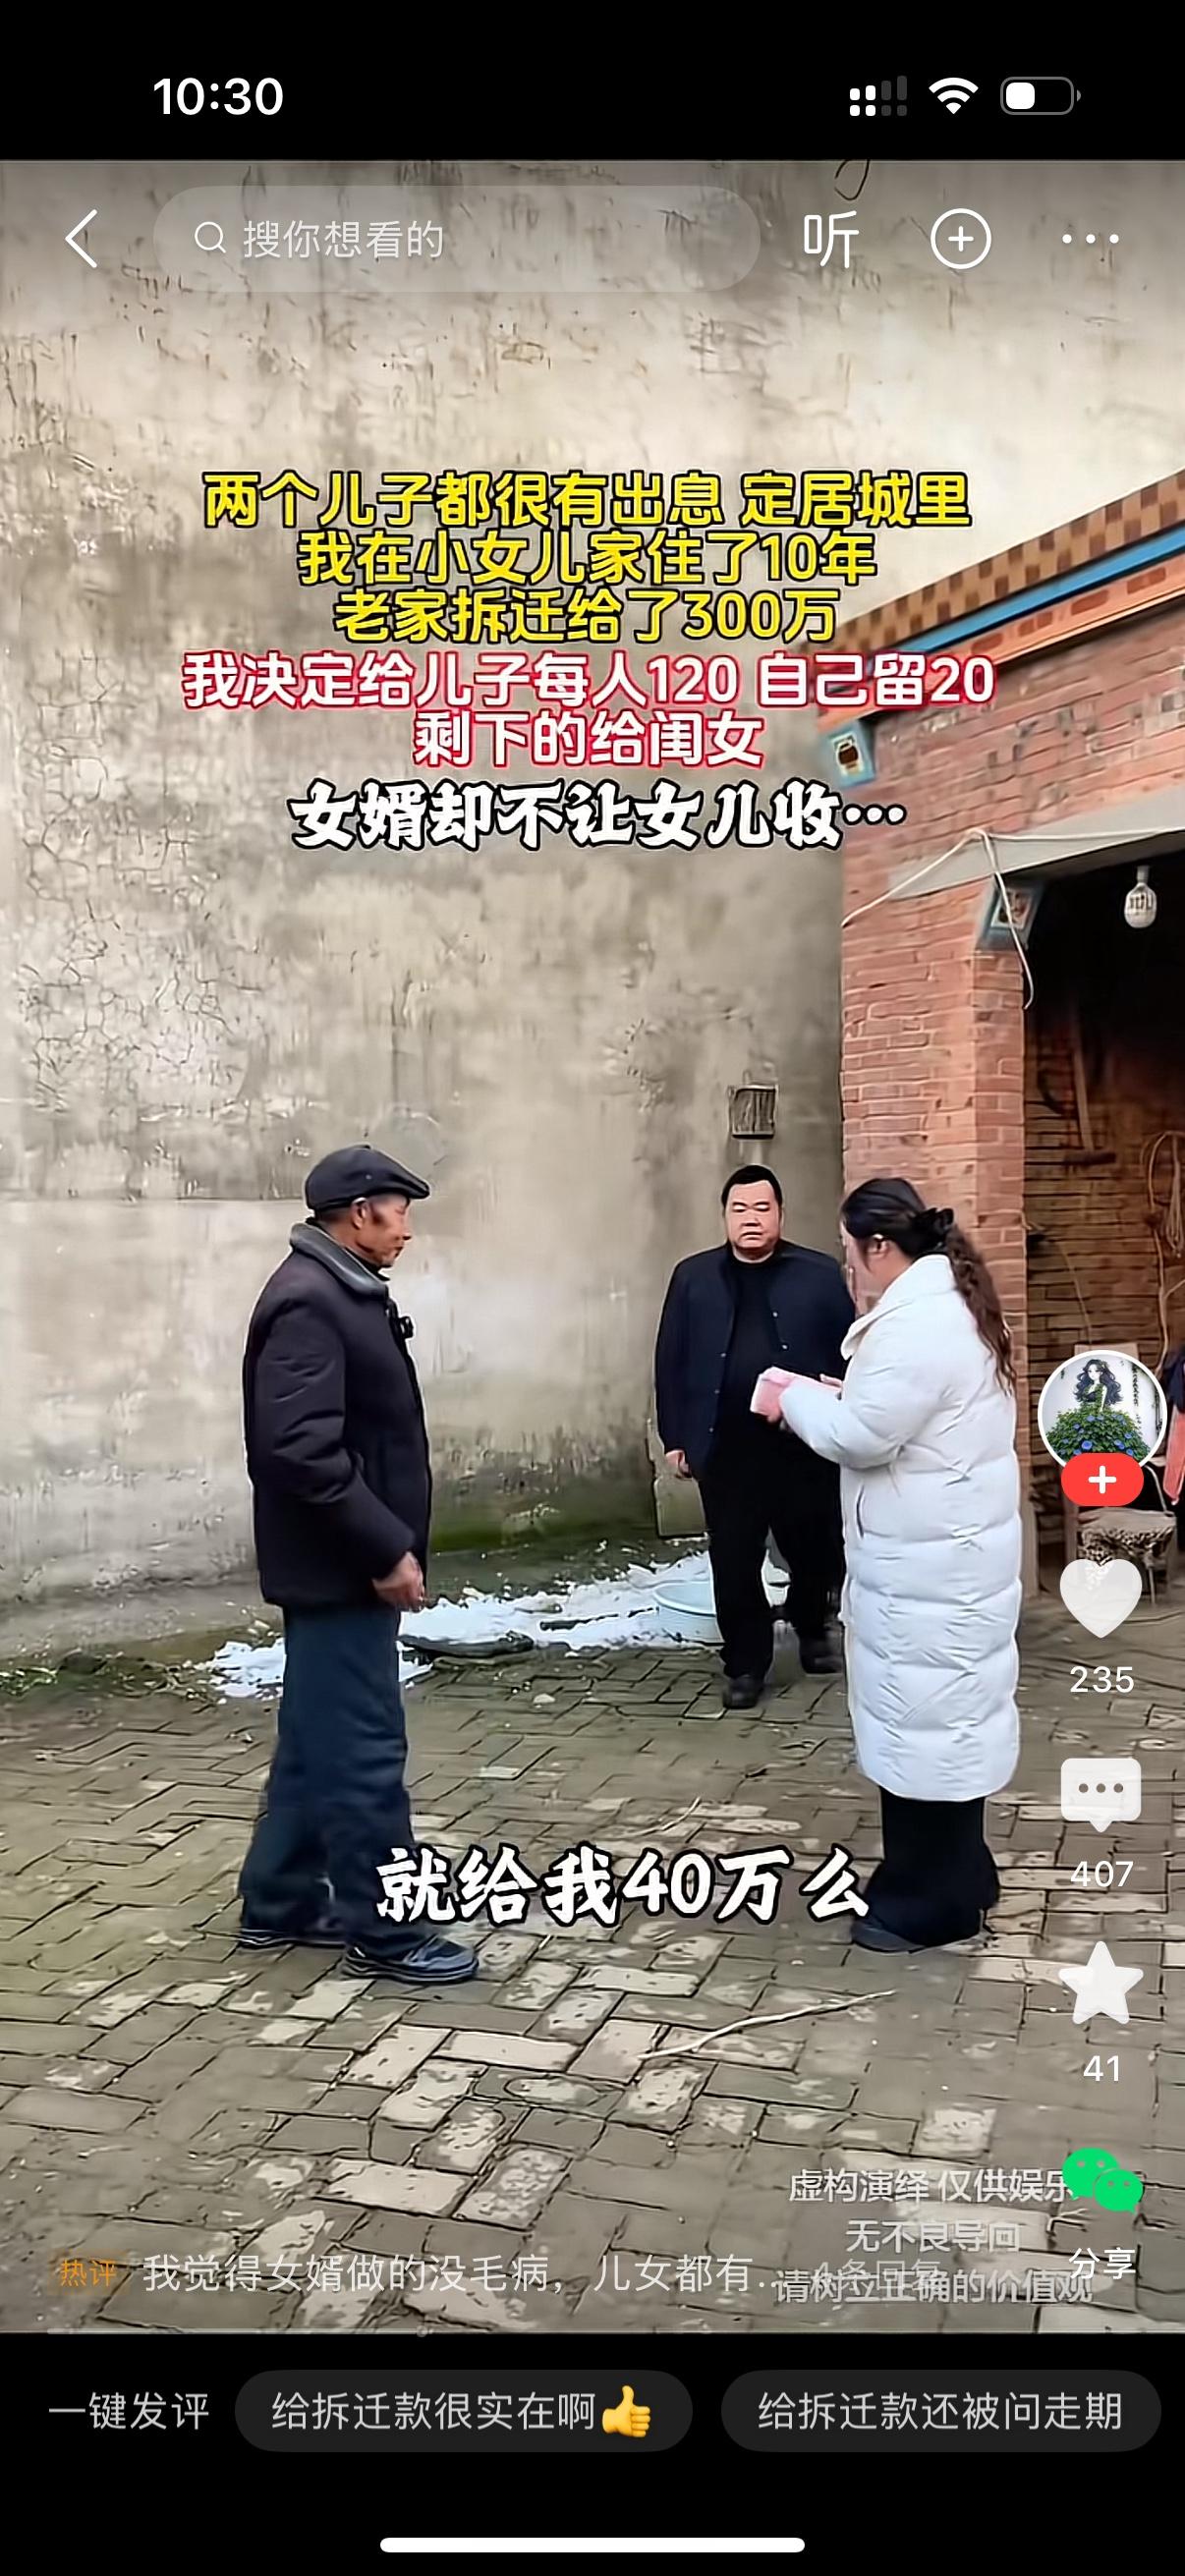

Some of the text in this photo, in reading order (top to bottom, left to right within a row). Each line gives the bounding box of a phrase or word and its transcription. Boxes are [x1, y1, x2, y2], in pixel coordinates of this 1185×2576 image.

[153, 77, 284, 116] 10:30
[243, 220, 445, 259] 搜你想看的
[803, 209, 860, 268] 听
[1069, 1664, 1135, 1694] 235
[1069, 1859, 1135, 1888] 407
[1082, 2054, 1121, 2083] 41
[59, 2259, 117, 2288] 热评
[1068, 2246, 1137, 2280] 分享
[48, 2391, 210, 2432] 一键发评
[271, 2390, 596, 2432] 给拆迁款很实在啊
[758, 2390, 1123, 2432] 给拆迁款还被问走期
